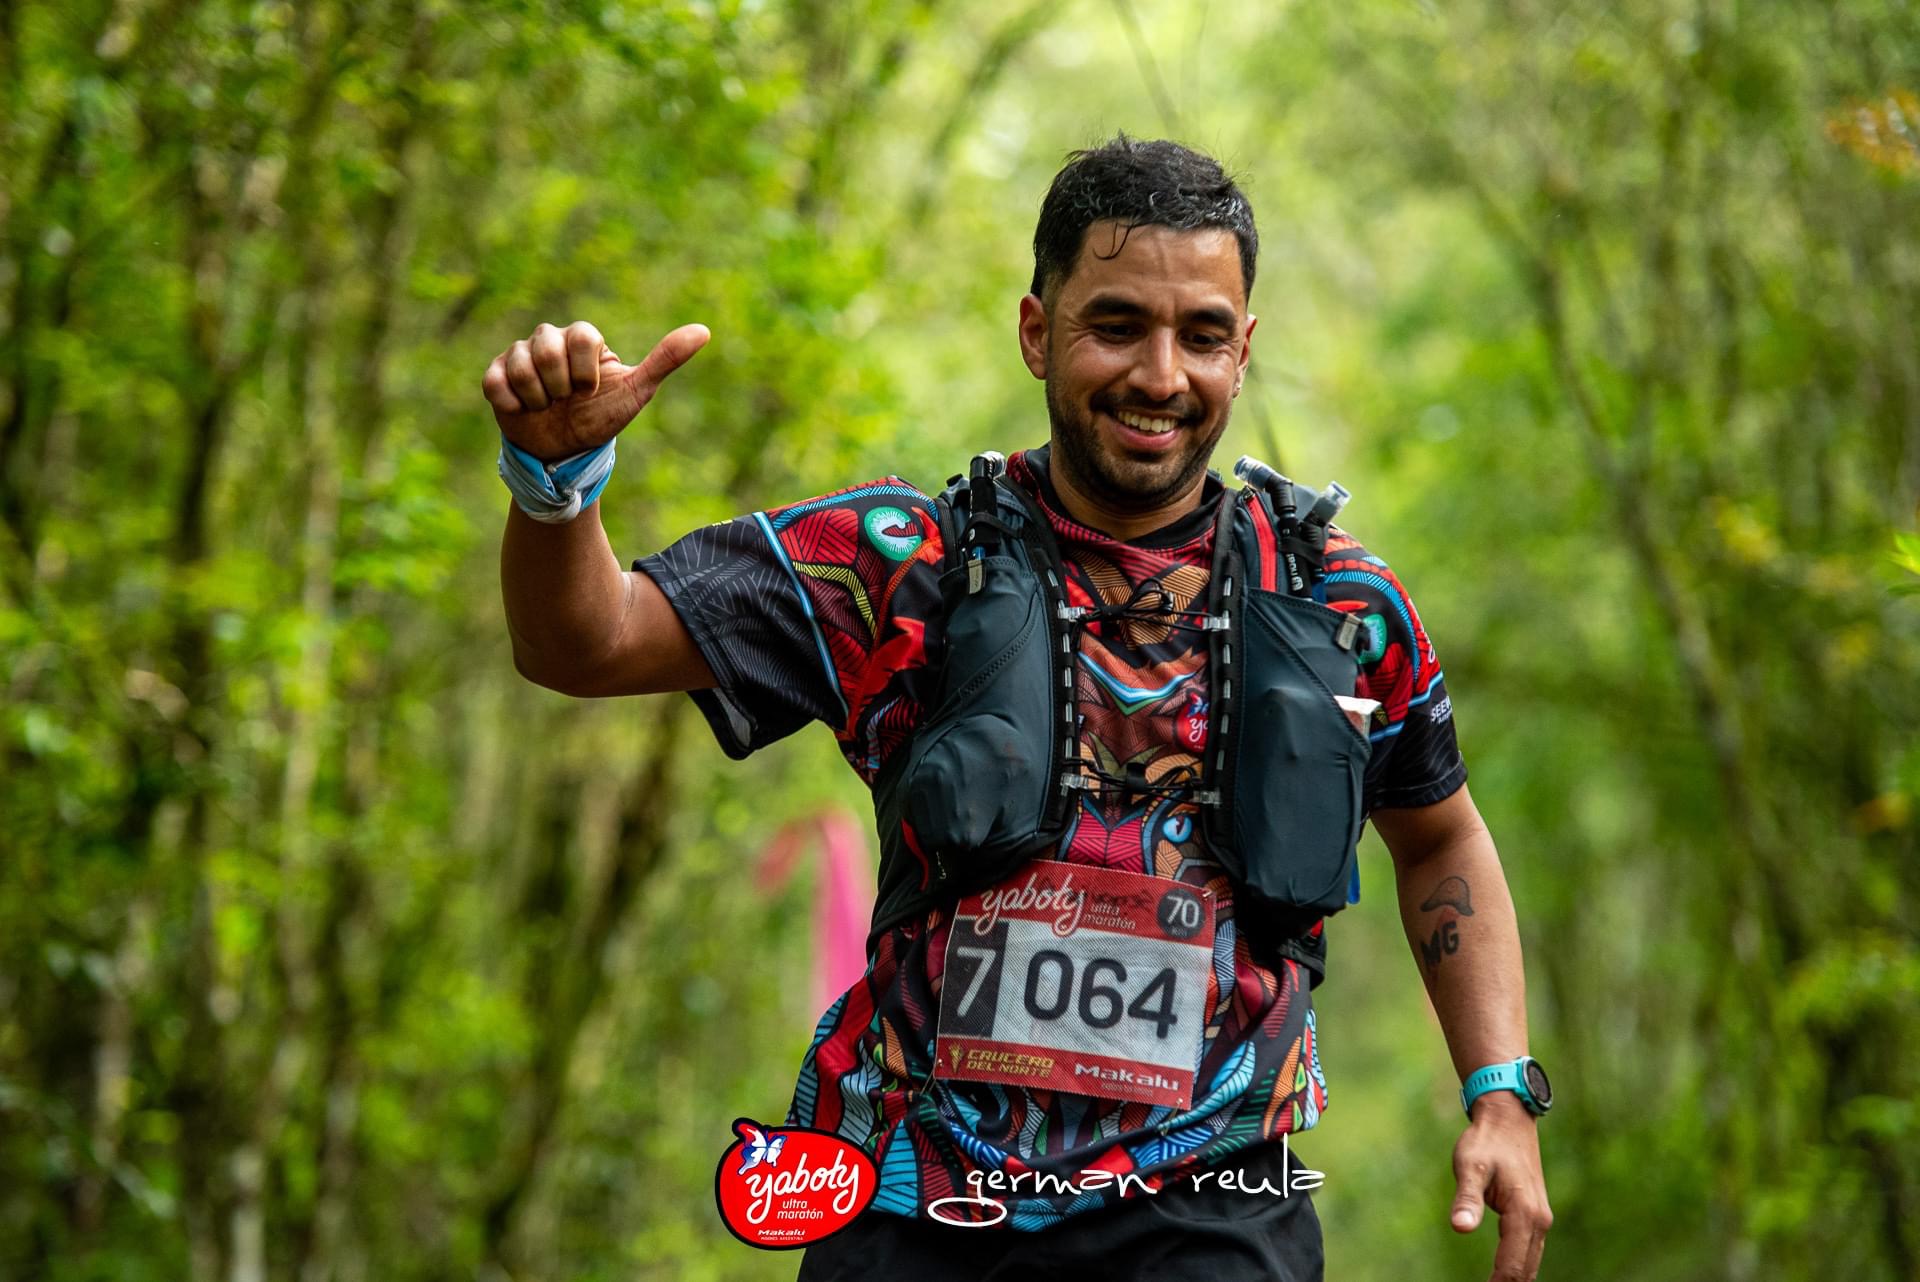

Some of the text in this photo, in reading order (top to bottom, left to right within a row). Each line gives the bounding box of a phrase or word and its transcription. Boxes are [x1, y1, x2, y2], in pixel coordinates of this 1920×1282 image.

[974, 872, 1088, 937] yaboty
[1091, 902, 1120, 916] ultra
[1167, 895, 1200, 928] 70
[957, 947, 1178, 1039] 7 064
[966, 1060, 1052, 1078] DEL NORTE
[967, 1049, 1055, 1069] CRUCERO
[1075, 1062, 1179, 1091] Makalu
